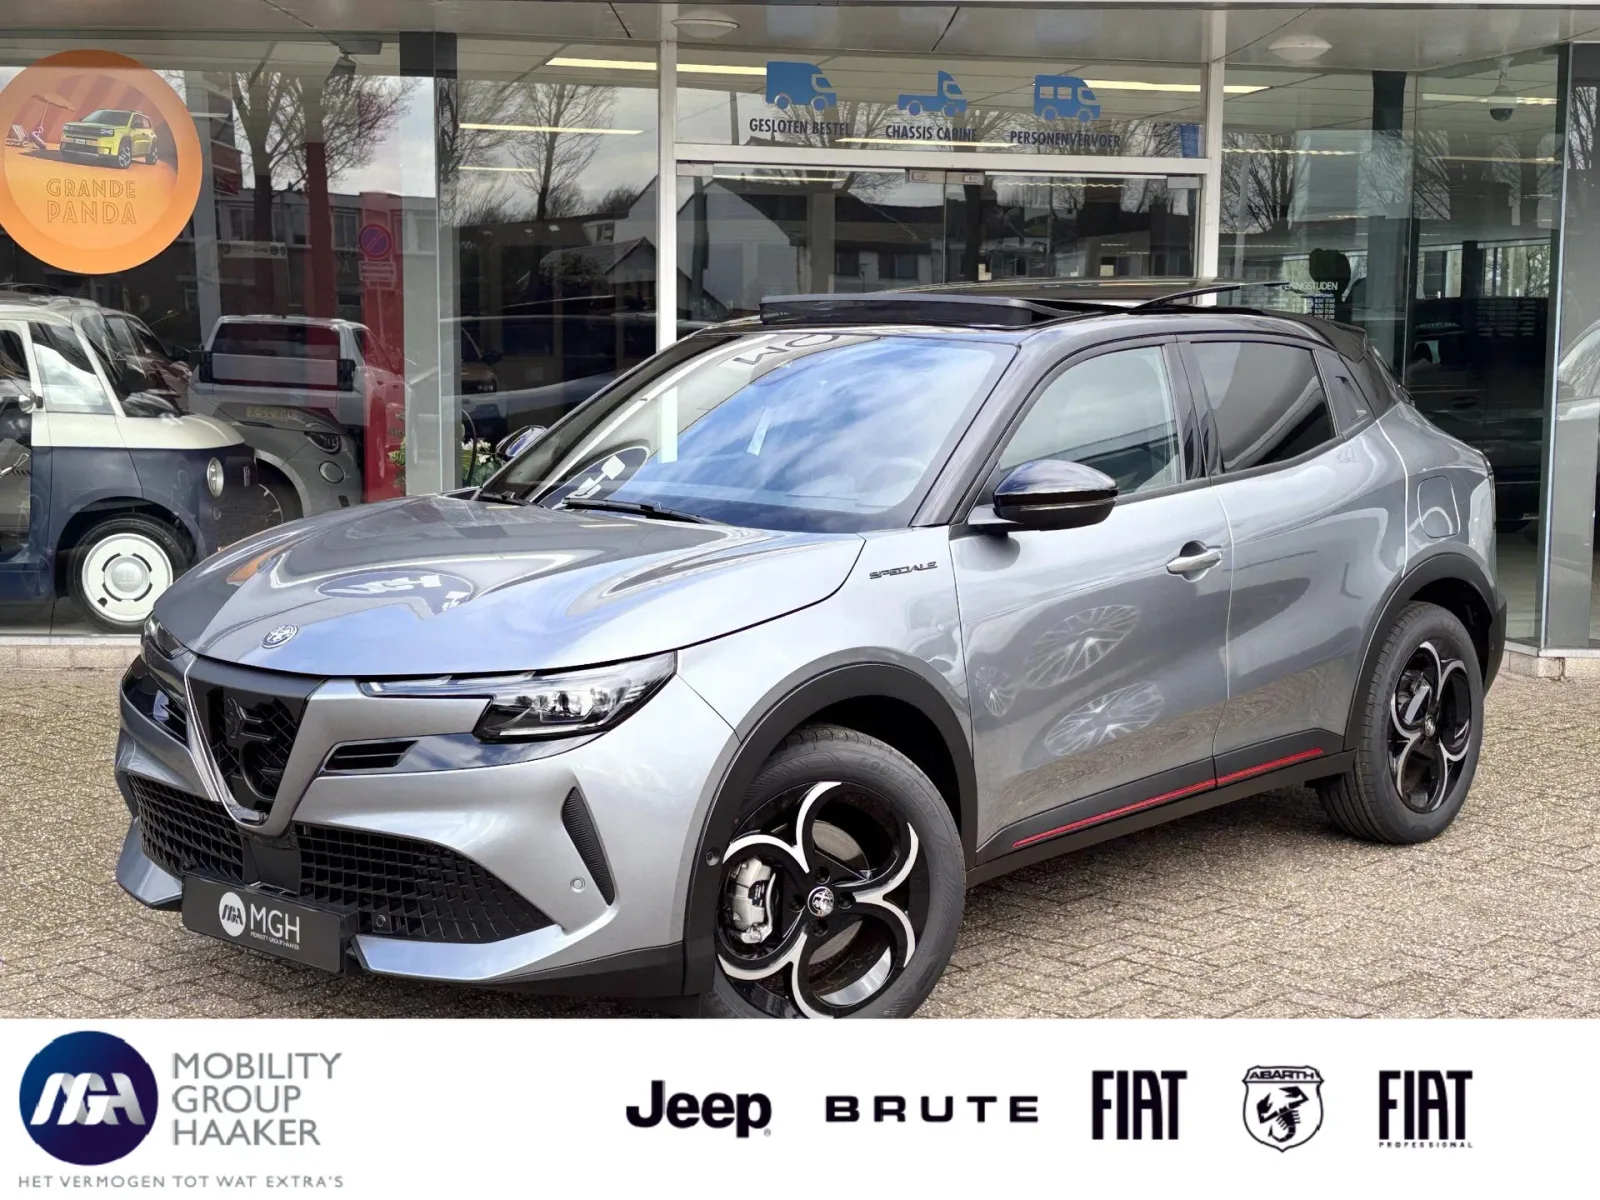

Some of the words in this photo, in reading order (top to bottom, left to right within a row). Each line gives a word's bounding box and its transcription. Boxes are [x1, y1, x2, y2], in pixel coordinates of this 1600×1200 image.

[750, 118, 808, 134] GESLOTEN
[812, 121, 850, 136] BESTEL
[885, 125, 933, 140] CHASSIS
[936, 127, 977, 142] CABINE
[1010, 130, 1121, 148] PERSONENVERVOER
[46, 178, 136, 199] GRANDE
[47, 200, 137, 225] PANDA
[869, 561, 938, 579] SPECIALE
[250, 903, 300, 943] MGH
